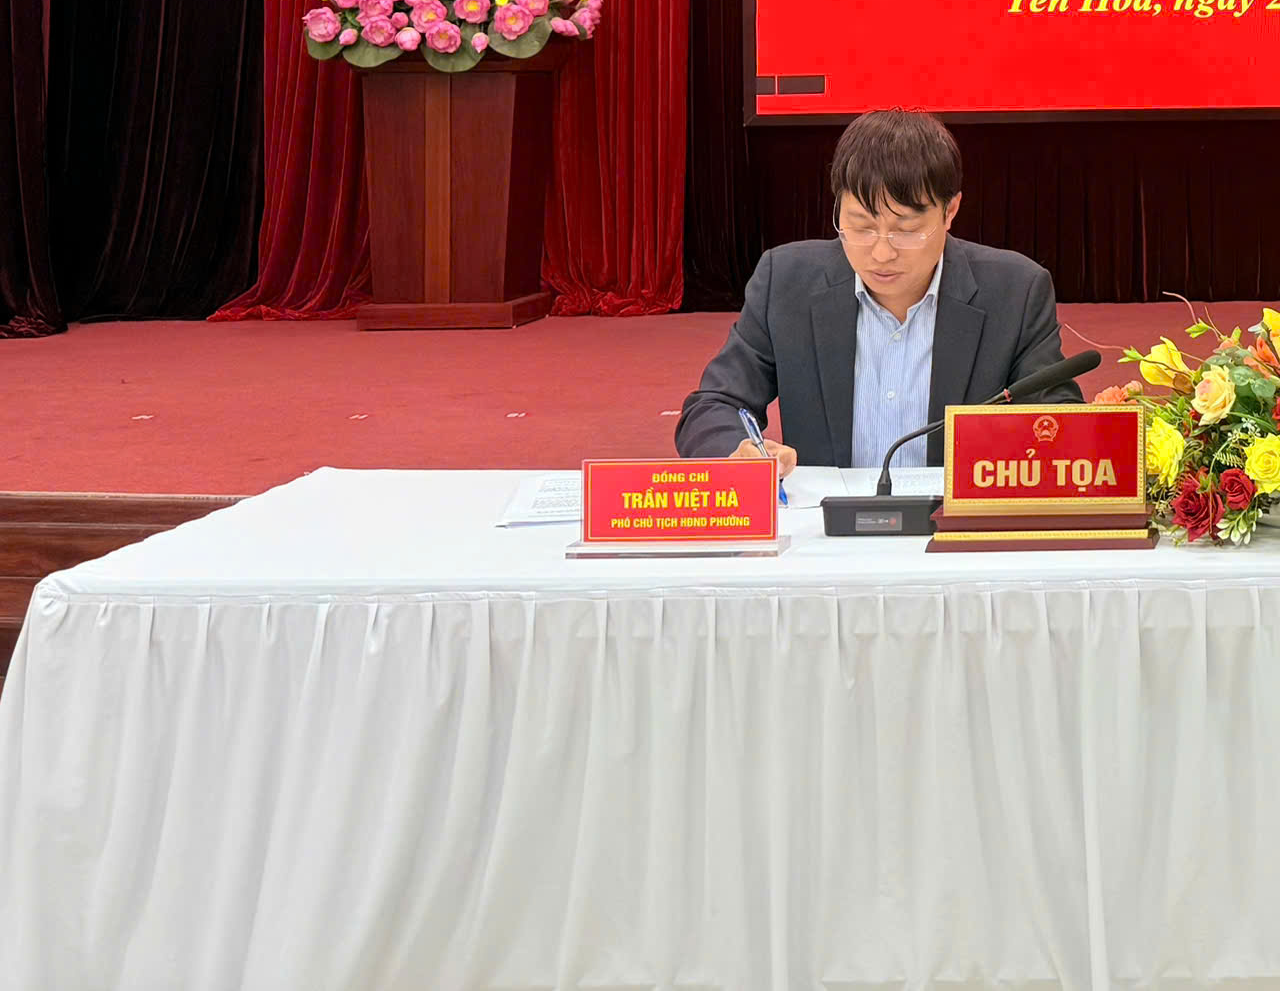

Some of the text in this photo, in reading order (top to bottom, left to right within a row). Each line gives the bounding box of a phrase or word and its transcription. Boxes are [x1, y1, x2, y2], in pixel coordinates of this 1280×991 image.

[688, 470, 710, 483] CHÍ
[973, 449, 1117, 492] CHỦ TỌA
[621, 487, 739, 511] TRẦN VIỆT HÀ
[610, 515, 631, 529] PHÓ
[633, 514, 654, 529] CHỦ
[656, 517, 679, 530] TỊCH
[710, 514, 751, 527] PHƯỜNG
